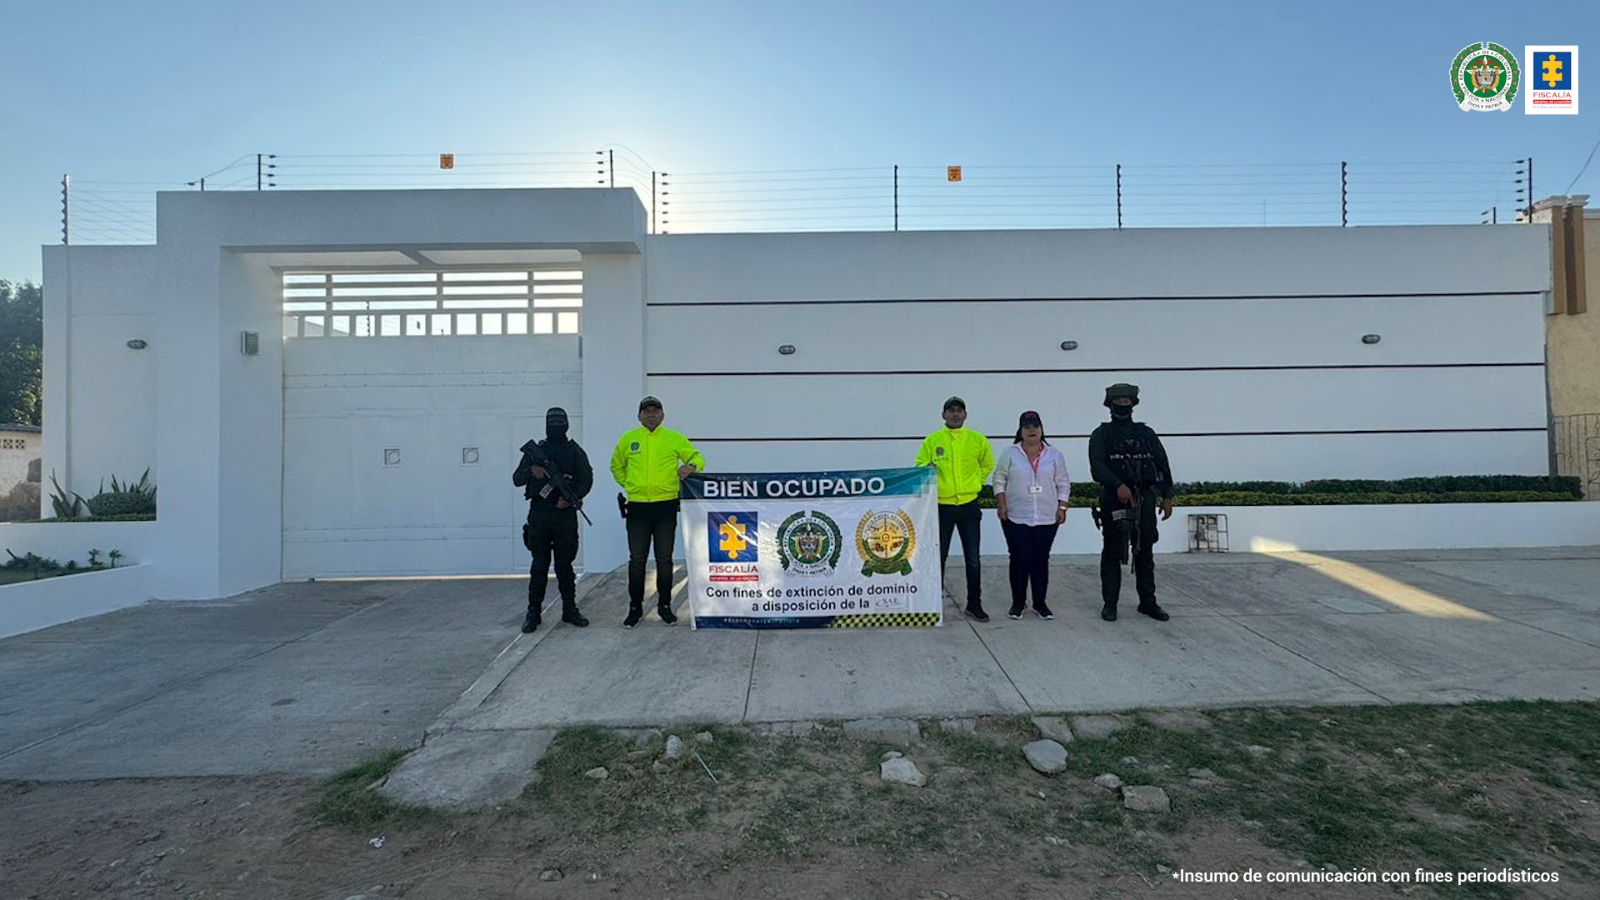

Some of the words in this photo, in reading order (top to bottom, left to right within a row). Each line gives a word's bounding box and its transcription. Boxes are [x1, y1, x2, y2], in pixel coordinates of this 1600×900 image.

[703, 480, 758, 498] BIEN
[766, 477, 885, 497] OCUPADO
[706, 586, 729, 598] Con
[733, 587, 762, 598] fines
[767, 587, 782, 597] de
[786, 585, 844, 597] extinción
[848, 585, 863, 595] de
[867, 583, 917, 595] dominio
[752, 603, 759, 611] a
[763, 599, 836, 613] disposición
[840, 599, 855, 609] de
[859, 599, 869, 608] la
